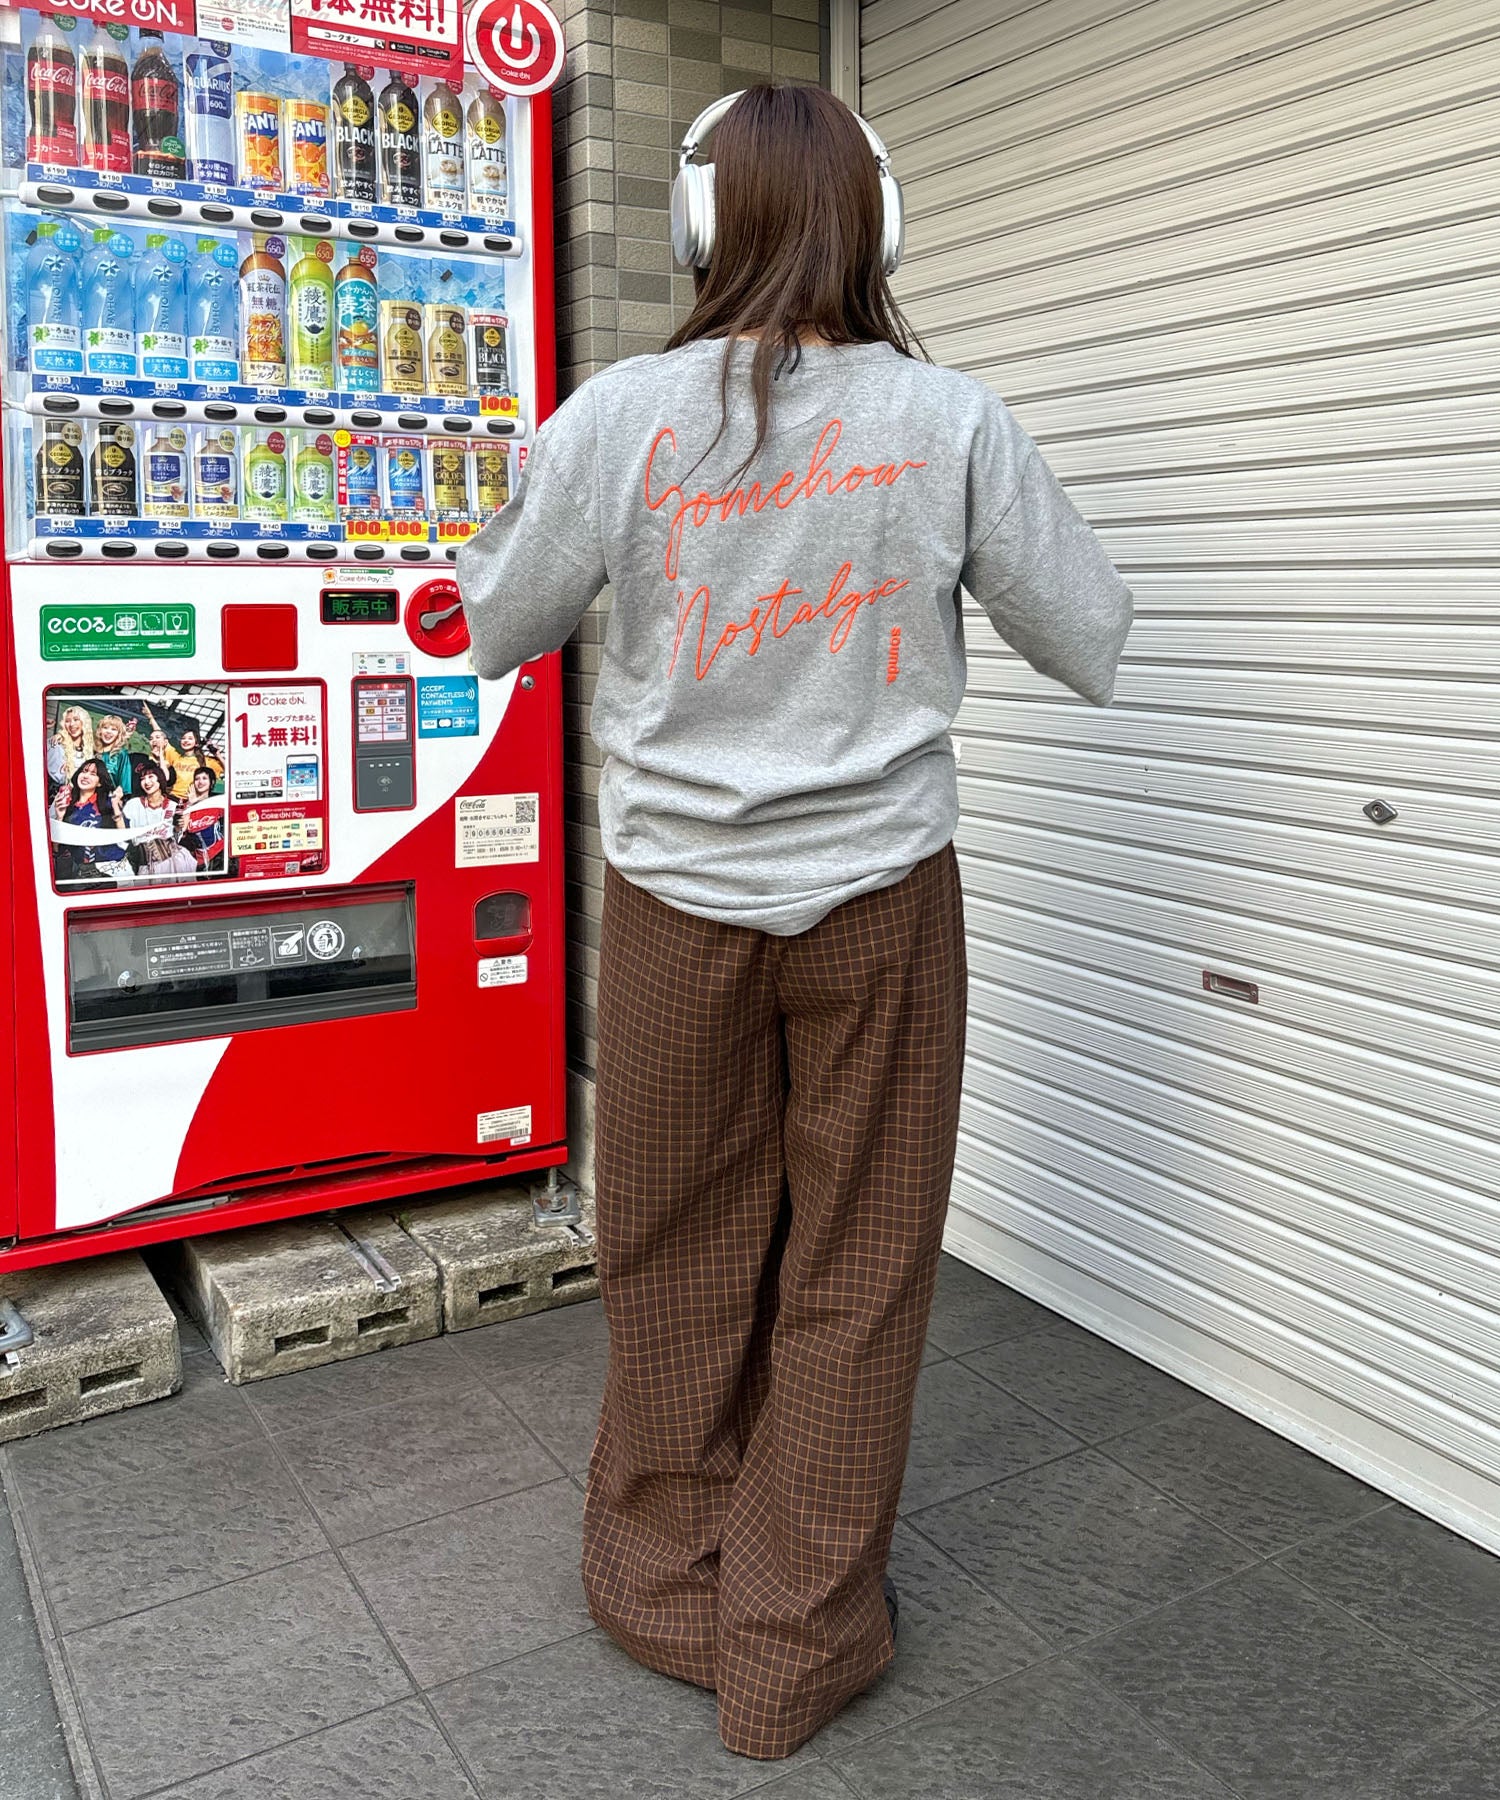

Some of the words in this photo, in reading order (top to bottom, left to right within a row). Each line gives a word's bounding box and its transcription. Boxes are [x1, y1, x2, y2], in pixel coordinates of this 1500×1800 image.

[48, 0, 125, 16] oke
[311, 0, 445, 35] 本無料!
[324, 31, 360, 44] コークオン
[500, 68, 518, 78] Coke
[519, 71, 531, 81] ON
[187, 76, 232, 93] AQUARIUS
[243, 112, 278, 131] FANT
[291, 119, 327, 139] FANT
[336, 126, 374, 147] BLACK
[382, 132, 419, 152] BLACK
[33, 143, 75, 157] コカ・コーラ
[428, 141, 464, 158] LATTE
[471, 147, 507, 164] LATTE
[88, 150, 129, 165] コカ・コーラ
[304, 286, 322, 323] 綾鷹
[338, 294, 377, 318] 麦茶
[43, 356, 76, 367] 天然水
[97, 359, 129, 370] 天然水
[478, 353, 506, 364] BLACK
[151, 363, 182, 374] 天然水
[202, 367, 232, 377] 天然水
[260, 464, 273, 491] 綾鷹
[308, 466, 321, 493] 綾鷹
[435, 471, 465, 480] GOLDEN
[479, 473, 507, 482] GOLDEN
[645, 418, 927, 581] Somehow
[367, 575, 381, 583] Pay
[332, 599, 388, 616] 販売中
[667, 561, 910, 681] Nostalgic
[262, 697, 287, 706] Coke
[289, 695, 305, 705] ON
[420, 692, 465, 700] CONTACTLESS
[267, 714, 317, 723] スタンプたまると
[235, 712, 317, 748] 1本無料!
[459, 798, 487, 809] Coca-Cola
[261, 812, 279, 820] Coke
[291, 811, 306, 820] Pay
